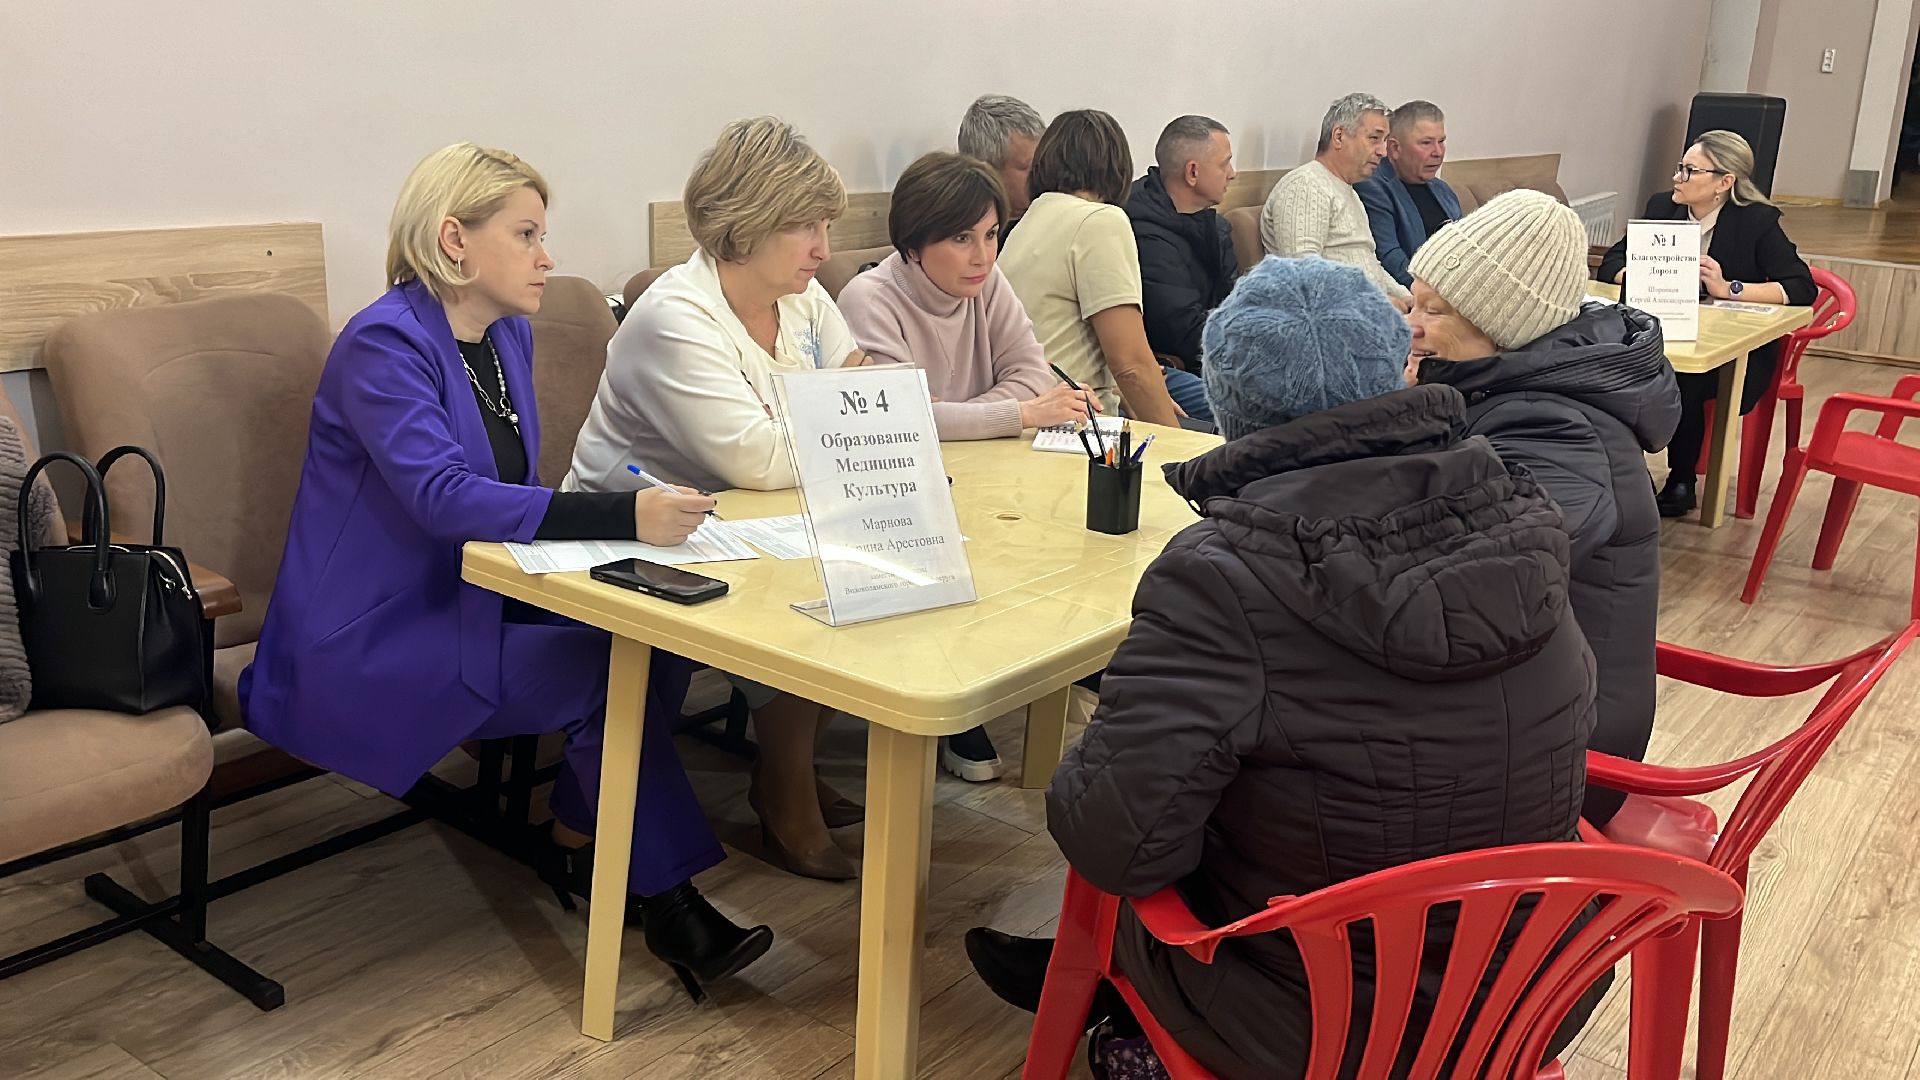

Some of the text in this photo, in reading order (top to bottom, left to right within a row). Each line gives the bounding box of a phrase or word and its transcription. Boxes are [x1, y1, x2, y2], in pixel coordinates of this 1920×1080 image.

[1651, 233, 1677, 247] № 1
[1631, 253, 1697, 263] Благоустройство
[1649, 266, 1678, 276] Дороги
[840, 389, 890, 416] № 4
[821, 431, 920, 451] Образование
[835, 456, 915, 473] Медицина
[843, 481, 917, 501] Культура
[887, 535, 945, 553] Арестовна
